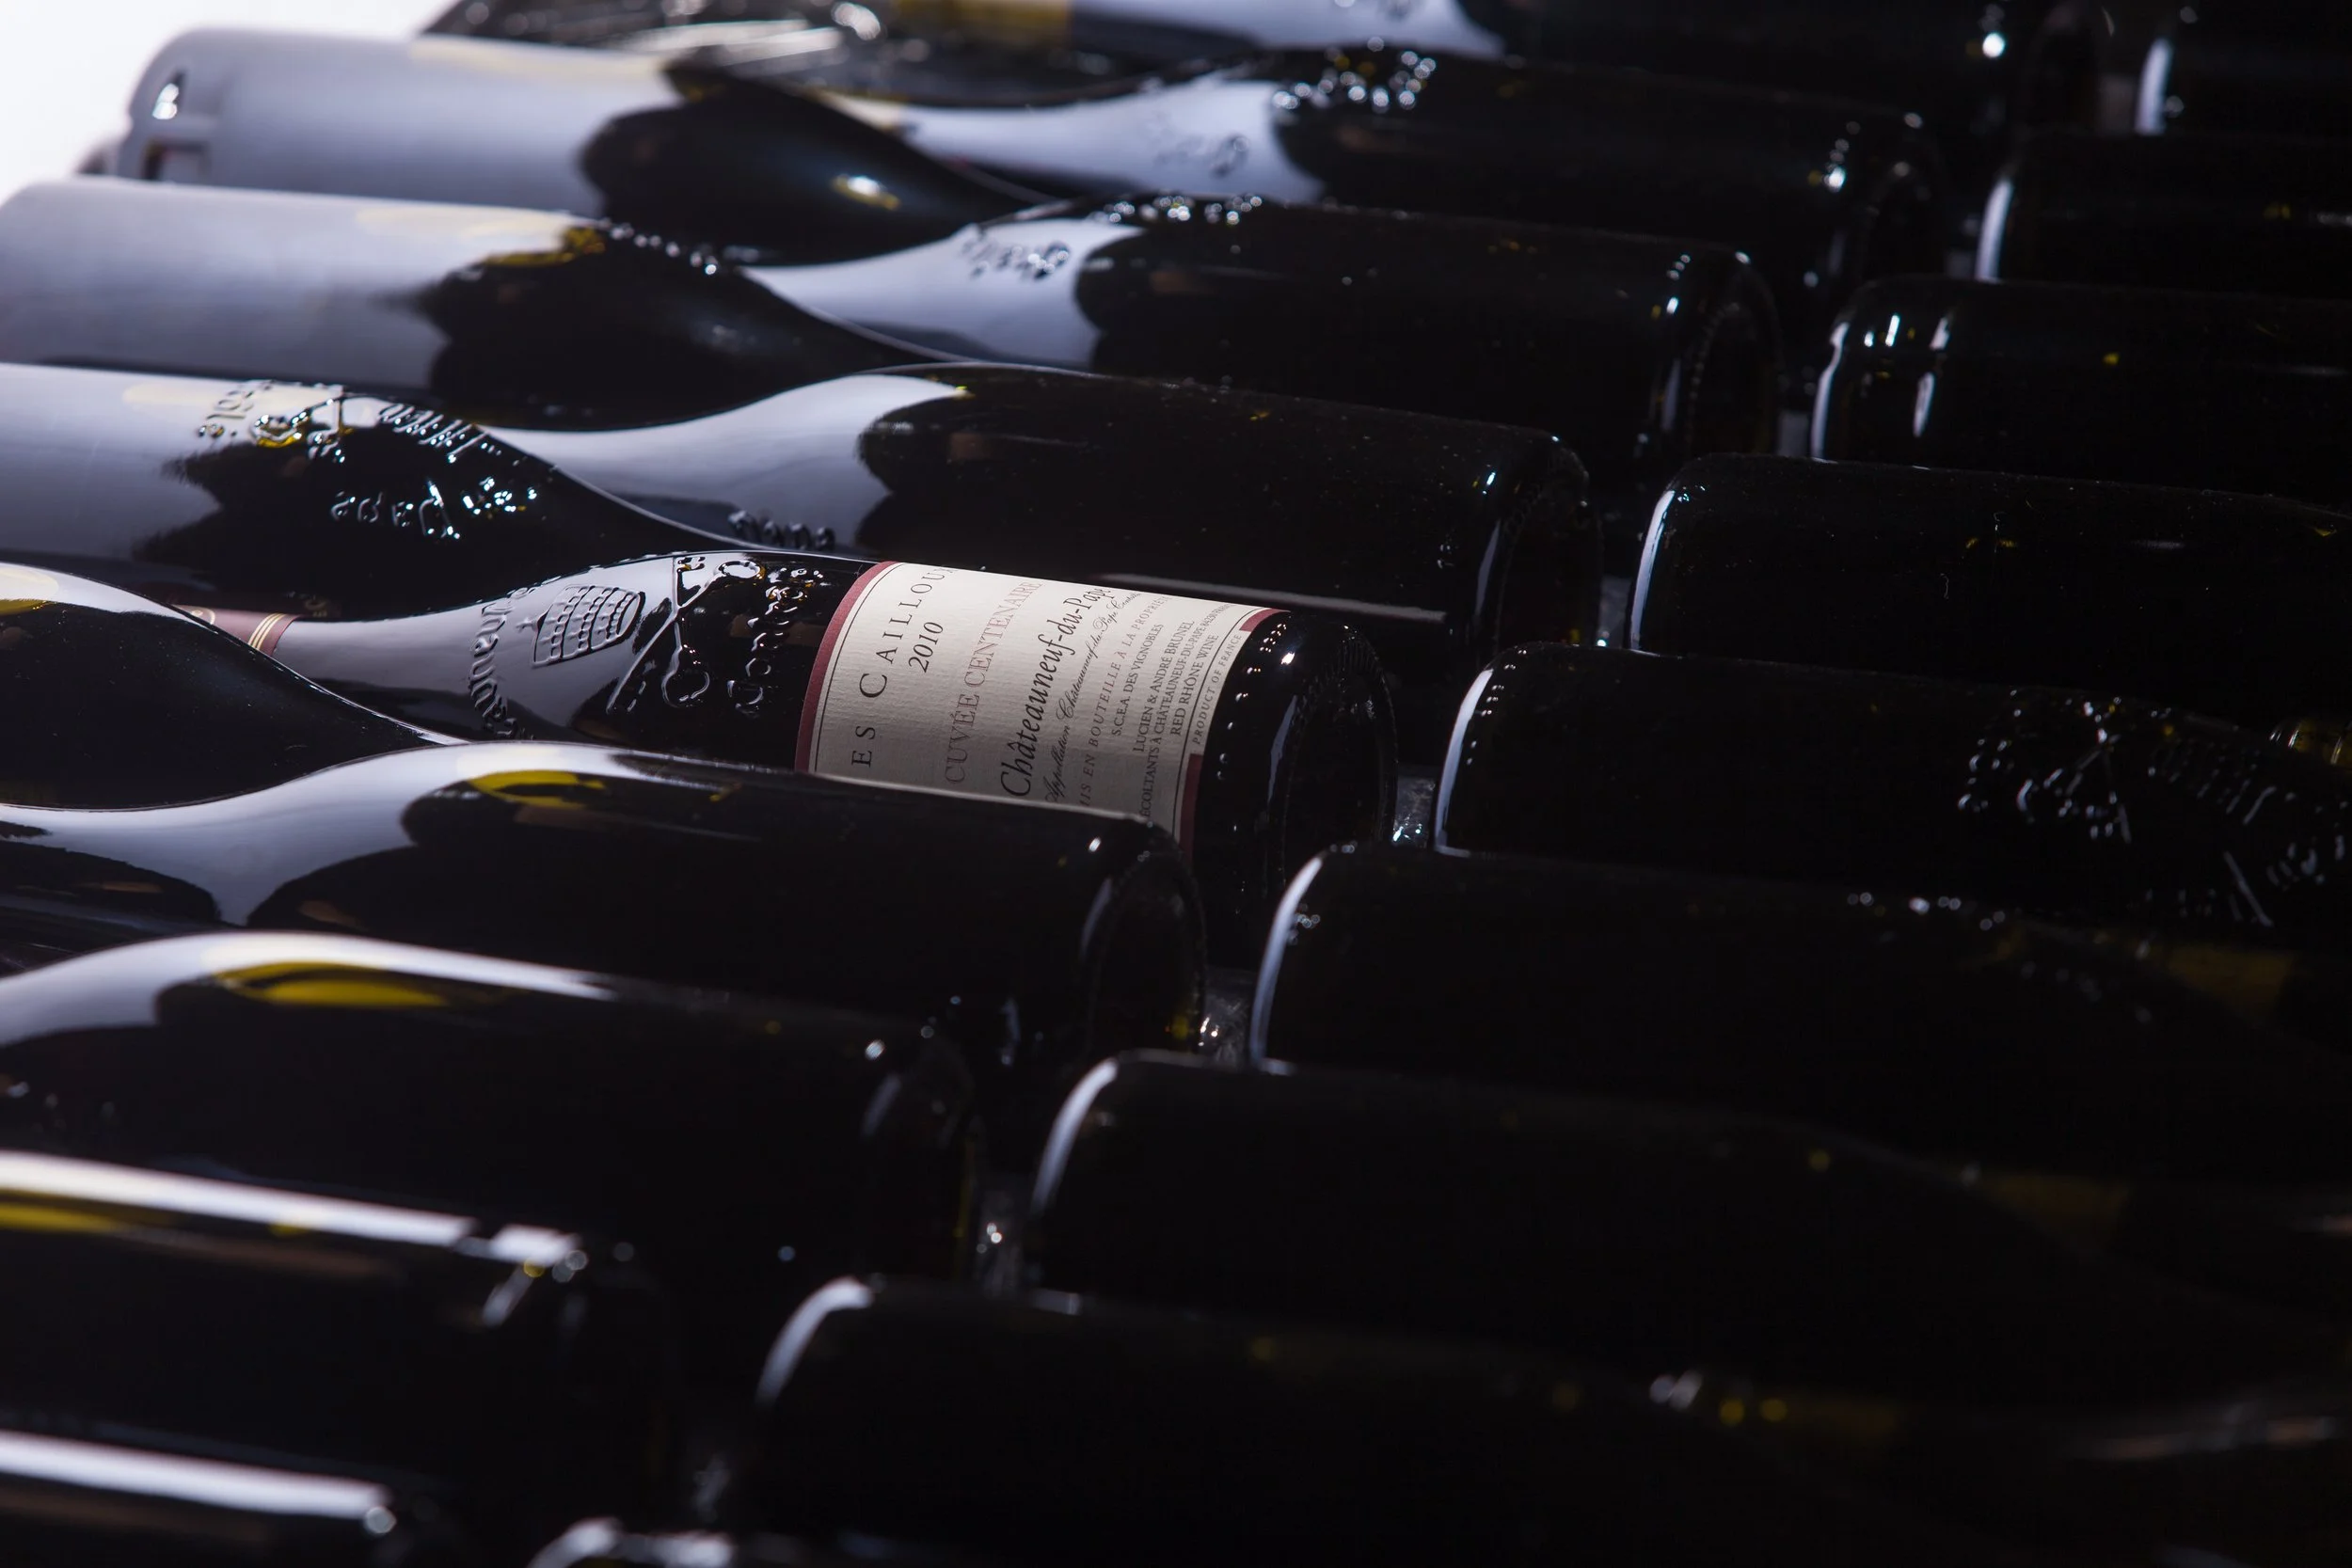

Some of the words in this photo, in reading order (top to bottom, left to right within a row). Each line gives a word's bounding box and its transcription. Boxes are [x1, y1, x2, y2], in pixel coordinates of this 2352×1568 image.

[908, 621, 944, 673] 2010
[945, 693, 980, 784] CUVÉE
[963, 580, 1044, 688] CENTENAIRE
[1056, 611, 1119, 721] Châteauneuf-du-Pape
[1114, 651, 1128, 661] À
[1122, 631, 1136, 647] LA
[1123, 672, 1138, 693] DES
[1132, 624, 1164, 670] VIGNOBLES
[1000, 587, 1116, 797] Châteauneuf-du-Pape
[1089, 661, 1121, 749] BOUTEILLE
[1133, 705, 1153, 752] LUCIEN
[1150, 657, 1173, 692] ANDRÉ
[1165, 620, 1196, 657] BRUNEL
[1139, 747, 1161, 817] ÉCOLTANTS
[1153, 626, 1206, 735] CHÂTEAUNEUF-DU-PAPE
[1170, 706, 1187, 736] RED
[1182, 659, 1204, 705] RHÔNE
[1196, 634, 1219, 660] WINE
[1192, 688, 1216, 745] PRODUCT
[1211, 669, 1222, 684] OF
[1220, 634, 1243, 667] FRANCE
[851, 725, 876, 768] ES
[1044, 725, 1072, 803] Appellation
[1083, 754, 1097, 778] EN
